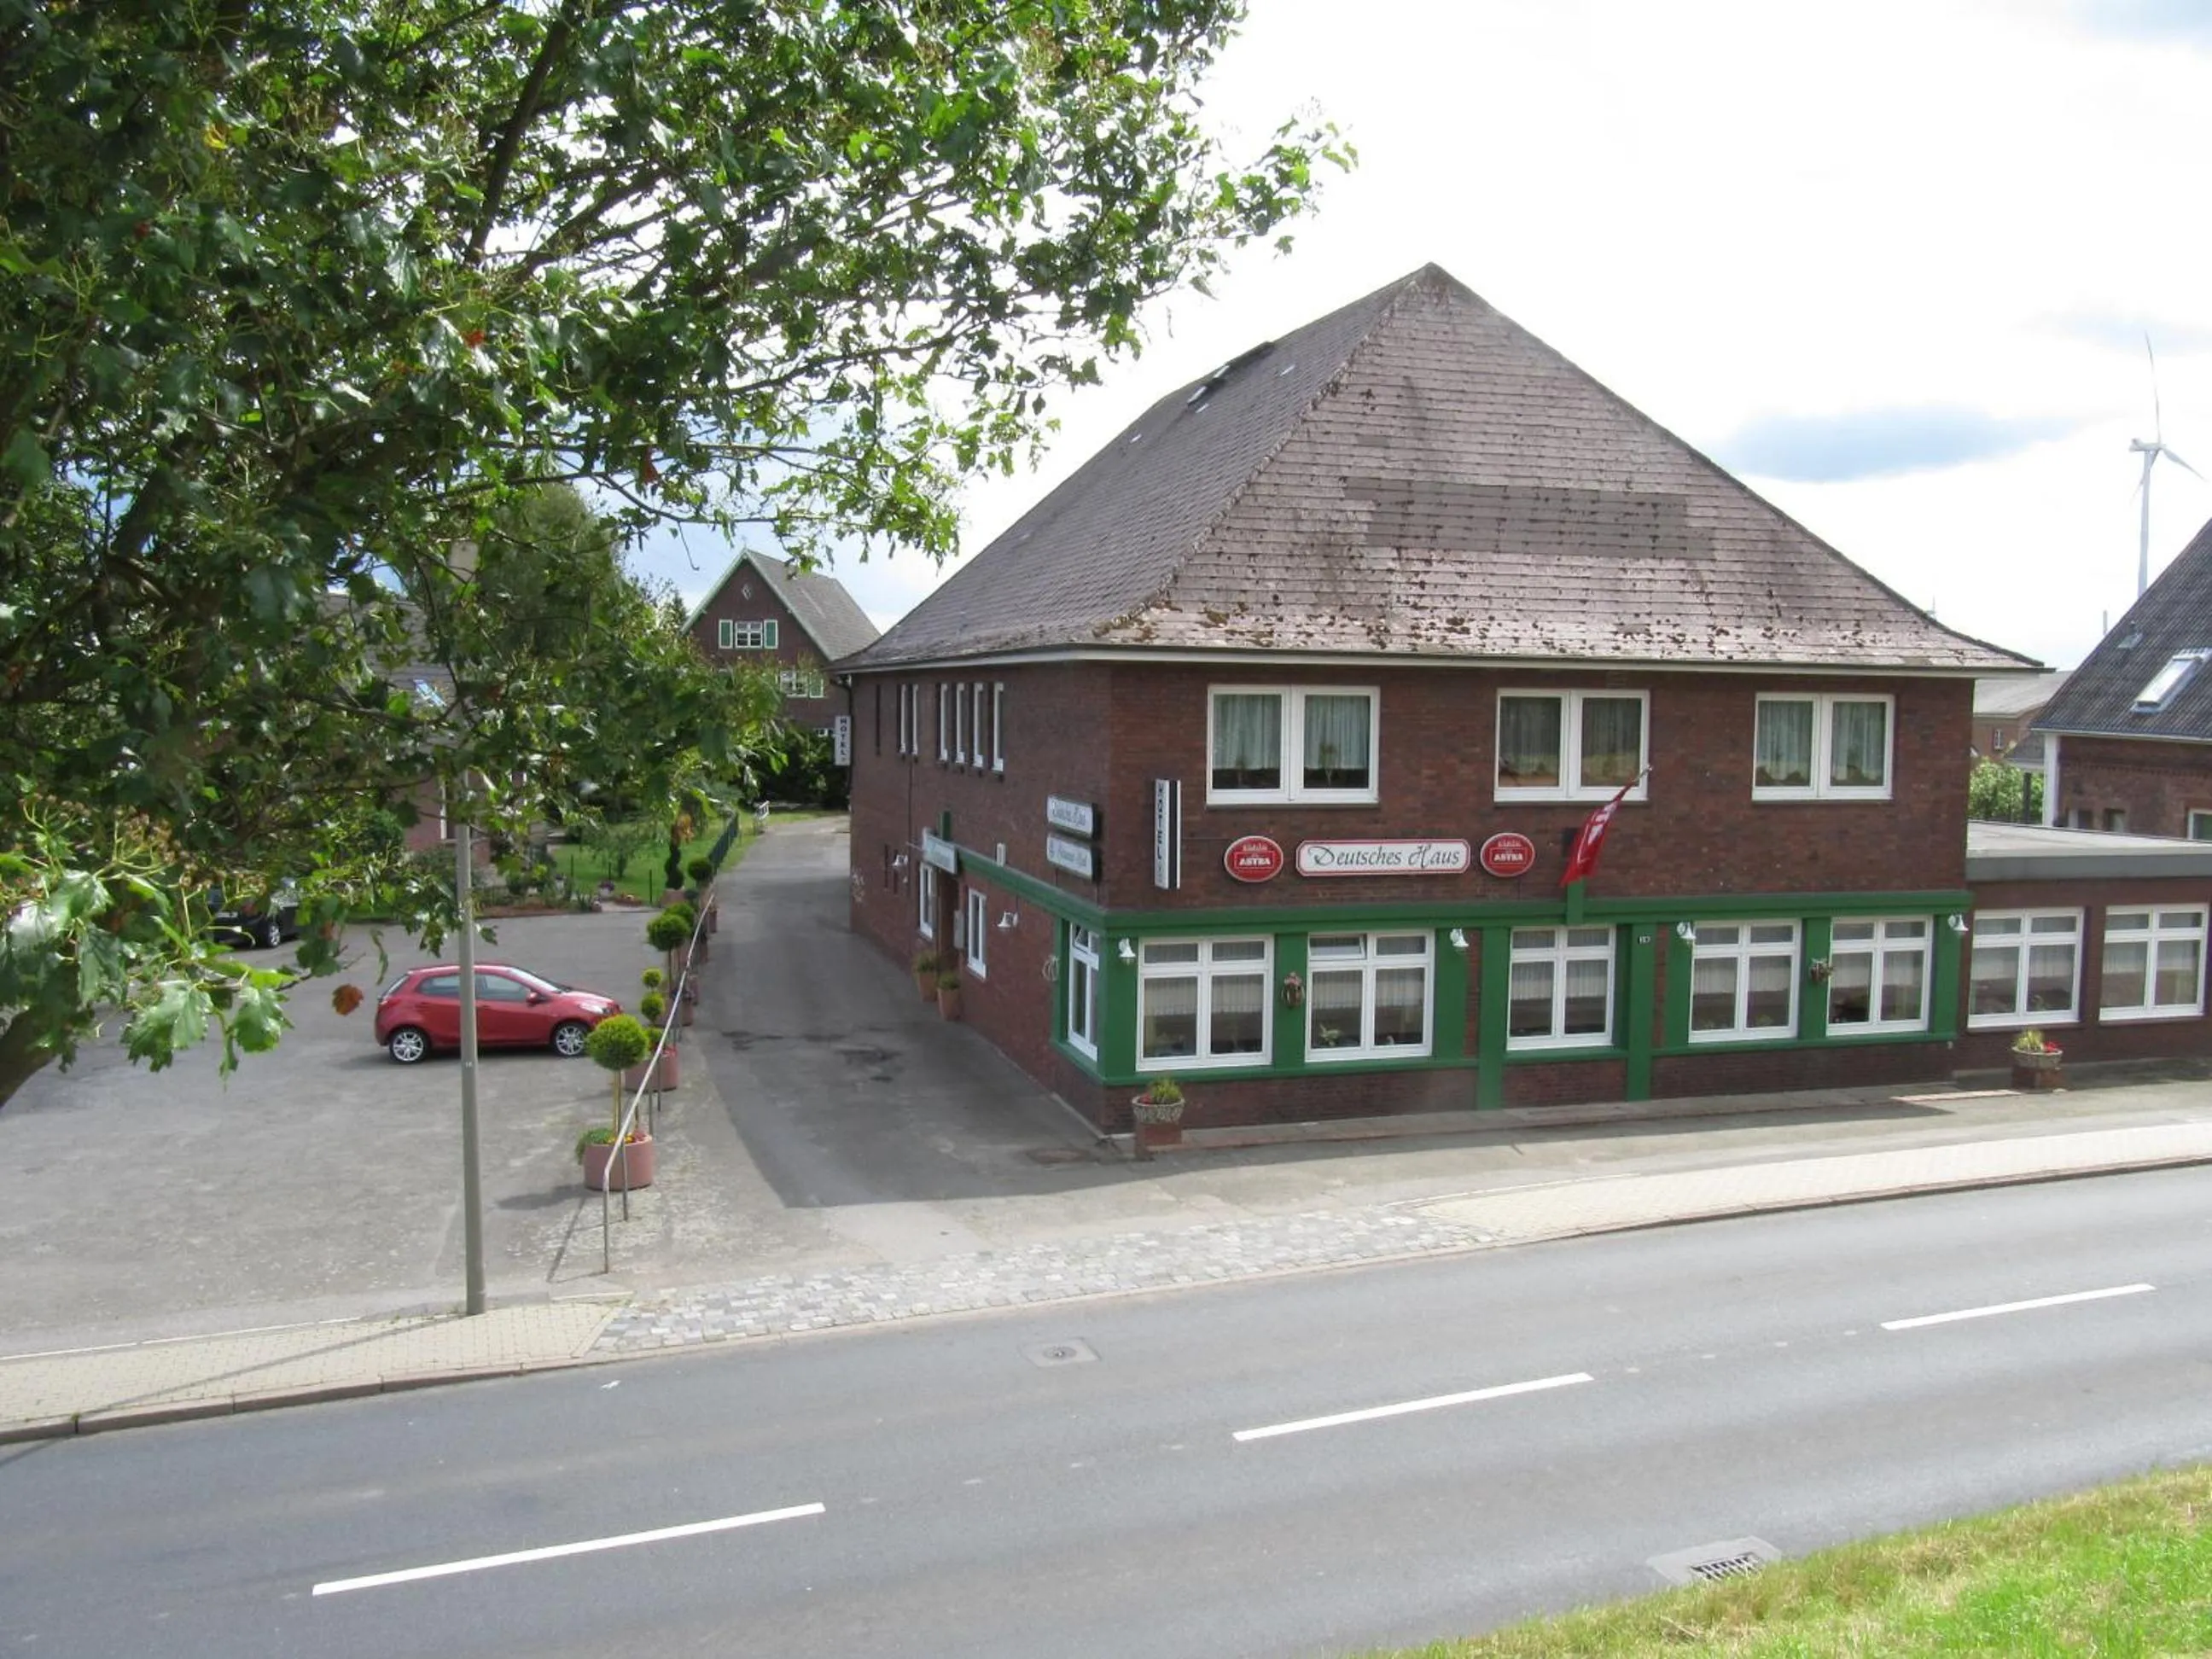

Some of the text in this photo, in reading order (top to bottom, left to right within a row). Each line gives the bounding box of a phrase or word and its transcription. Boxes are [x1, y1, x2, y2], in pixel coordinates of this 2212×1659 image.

[1239, 857, 1271, 866] ASTRA
[1308, 842, 1461, 870] Deutsches Haus
